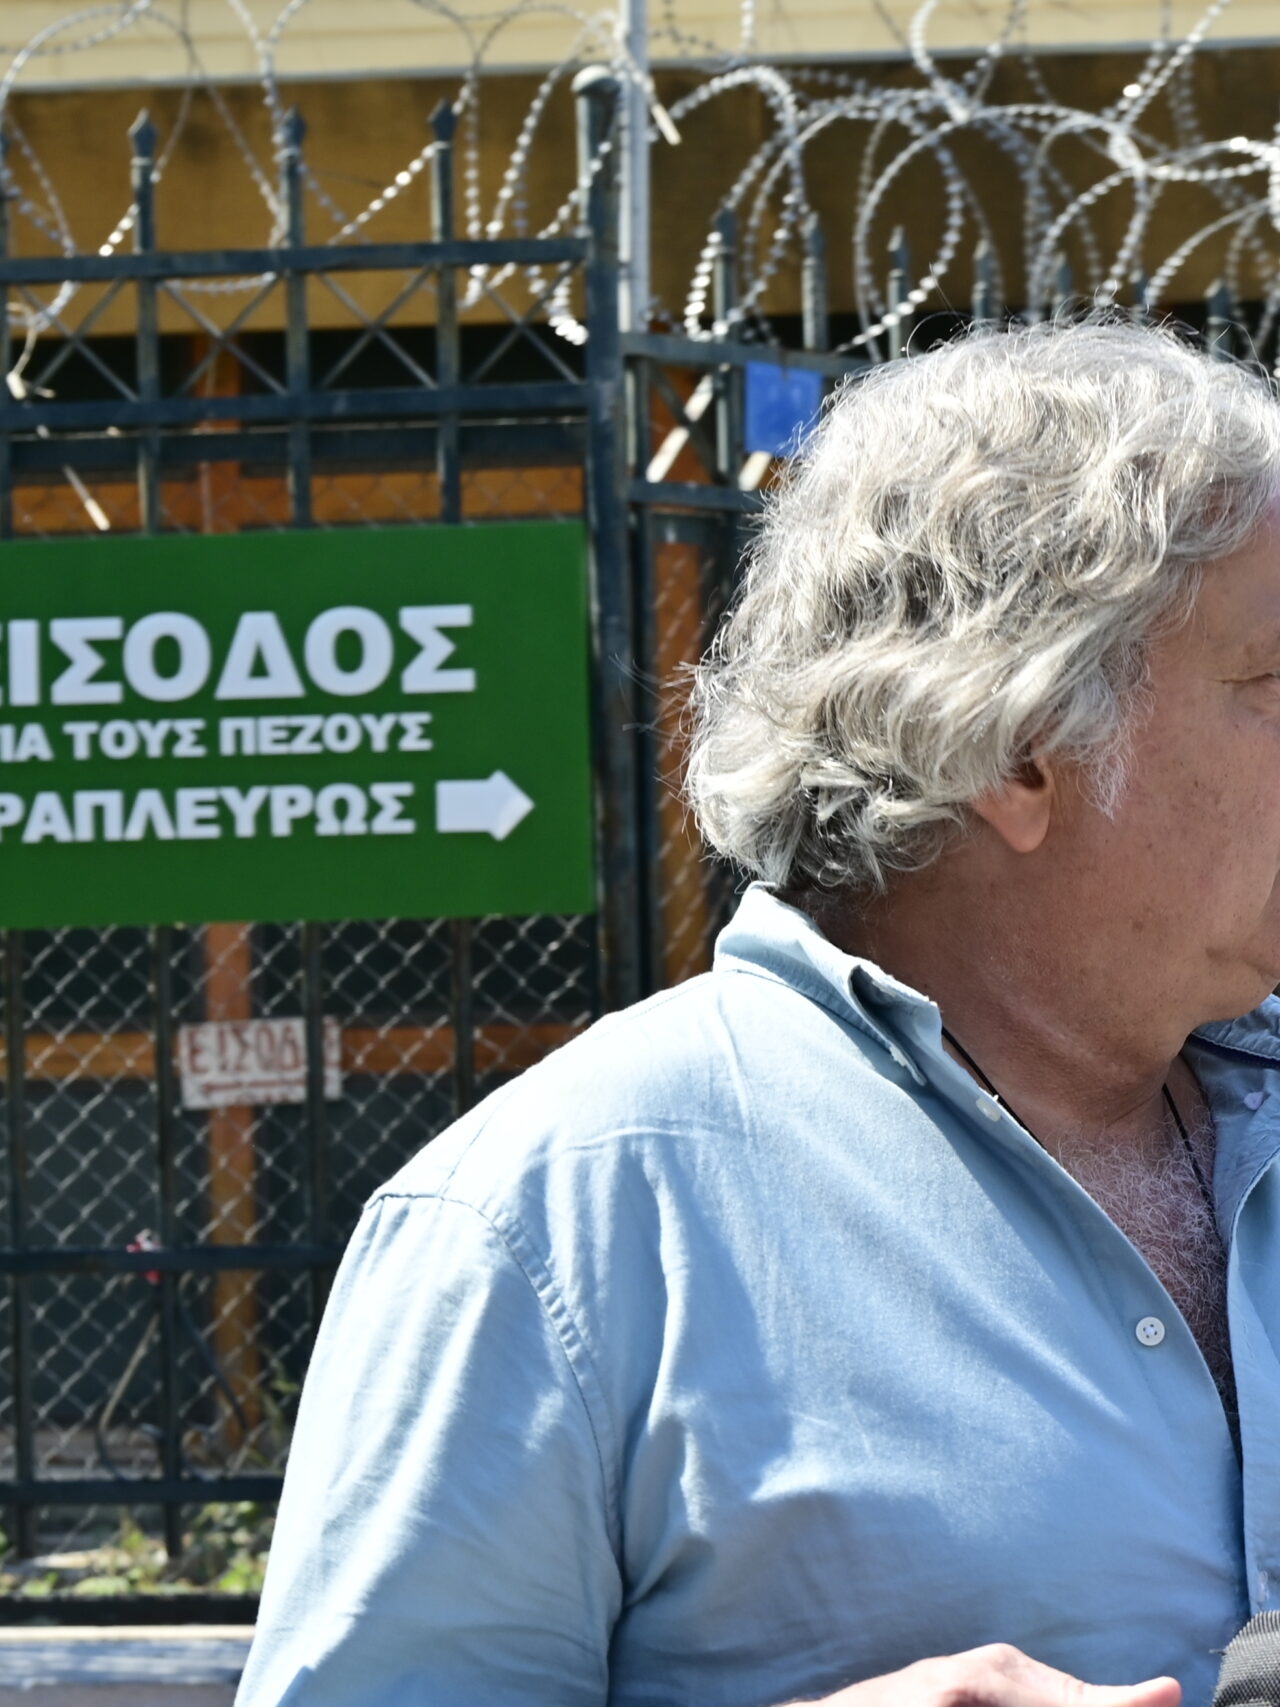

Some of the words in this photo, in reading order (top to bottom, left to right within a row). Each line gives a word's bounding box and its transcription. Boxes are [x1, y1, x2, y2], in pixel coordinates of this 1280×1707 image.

[0, 604, 476, 706] ΙΣΟΔΟΣ
[63, 719, 206, 761] ΤΟΥΣ
[219, 712, 433, 756] ΠΕΖΟΥΣ
